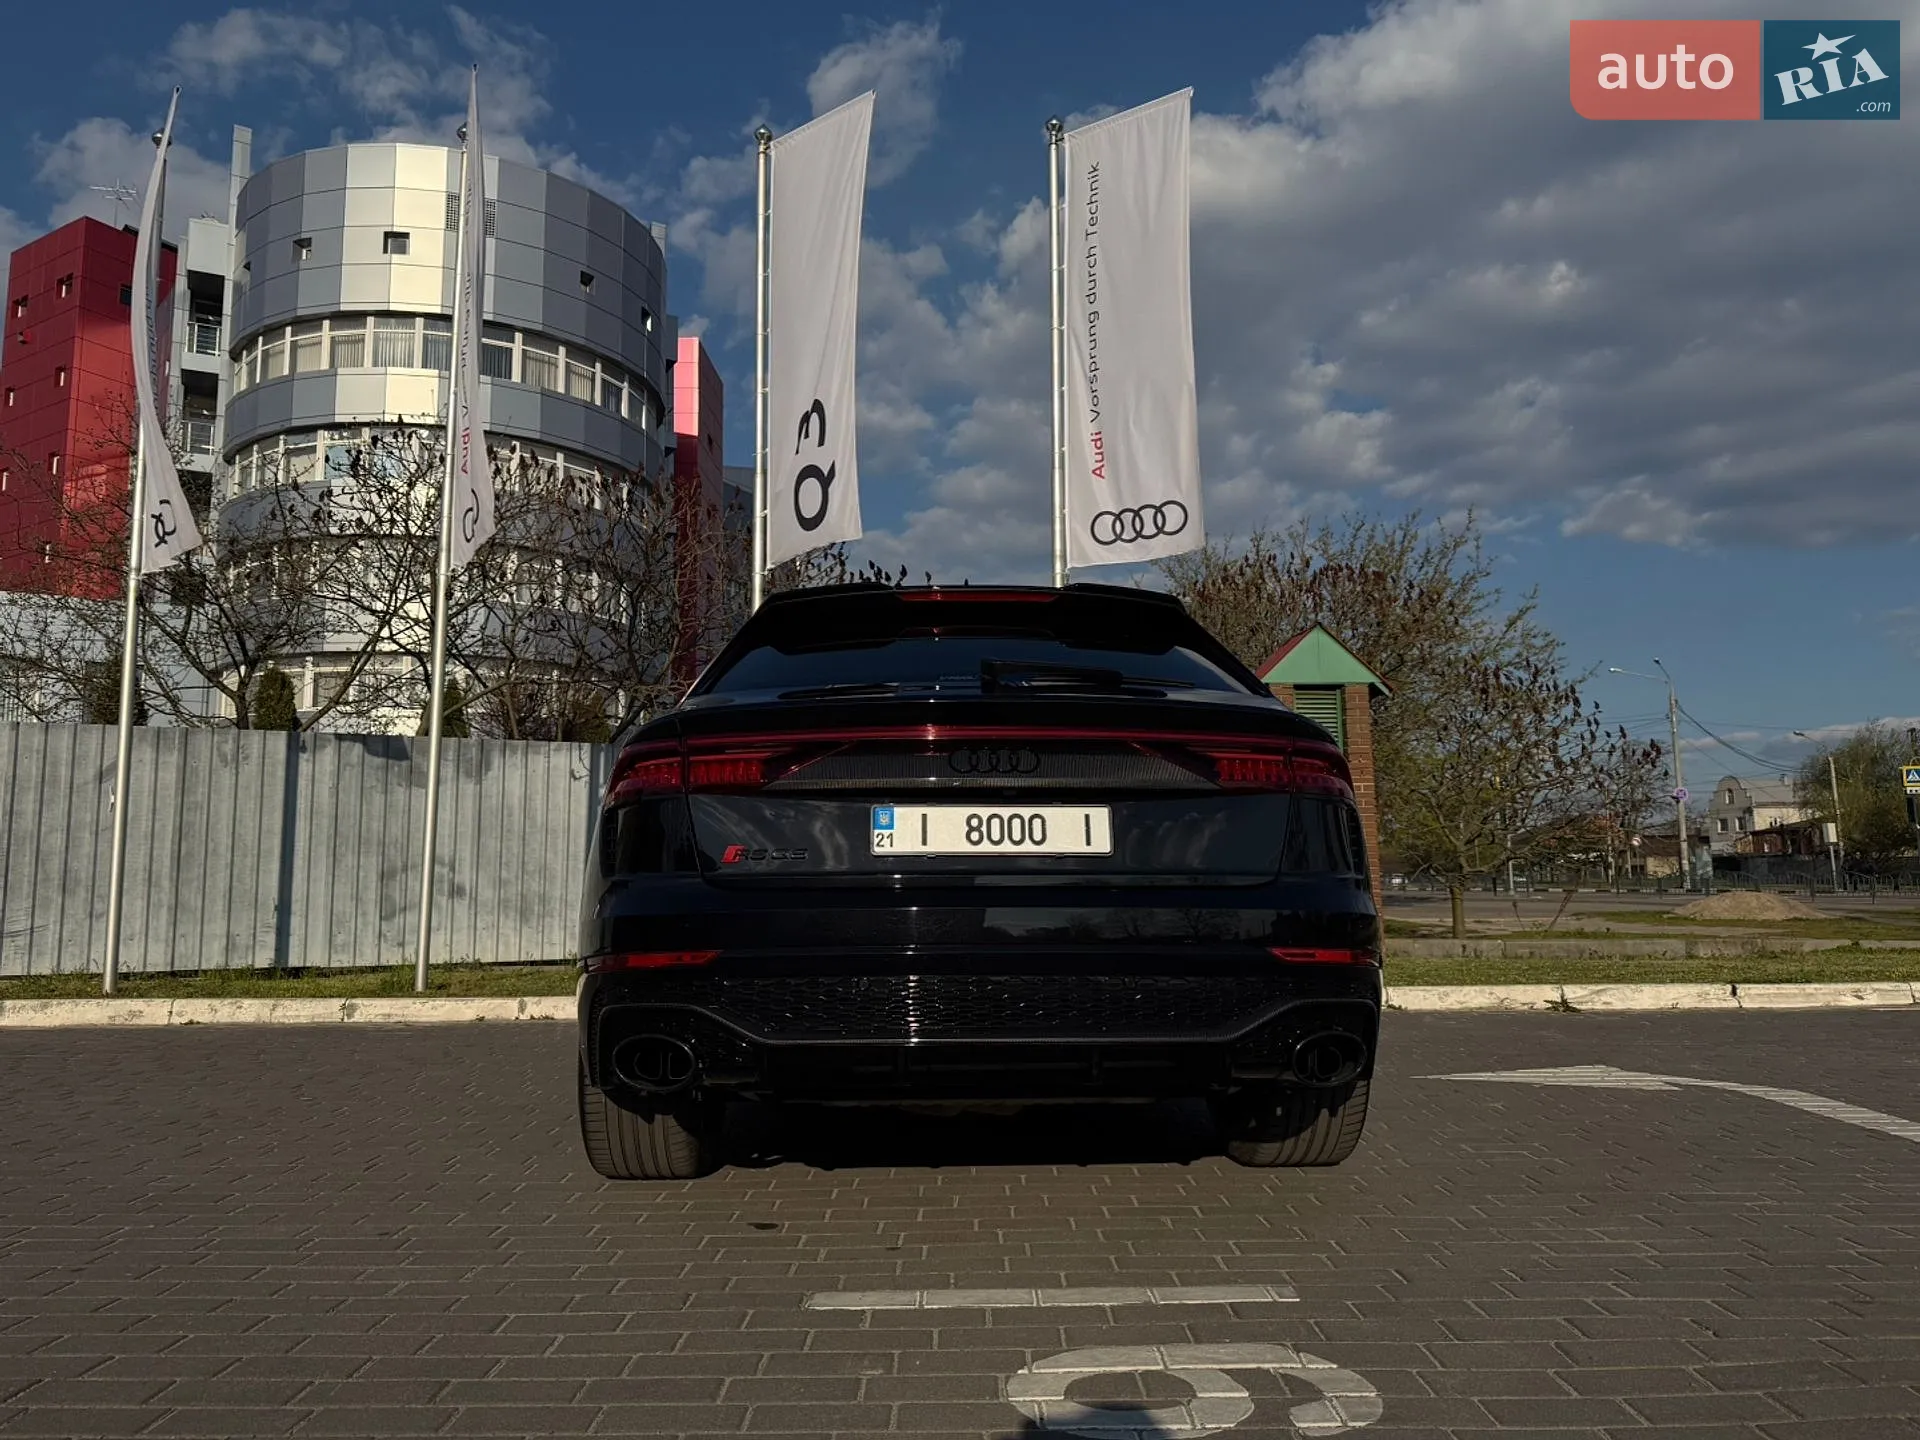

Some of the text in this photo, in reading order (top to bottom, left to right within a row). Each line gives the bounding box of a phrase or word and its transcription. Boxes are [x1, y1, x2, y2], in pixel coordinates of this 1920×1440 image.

[1084, 161, 1105, 479] Audi Vorsprung durch Technik
[461, 427, 471, 475] Audi
[794, 398, 836, 532] Q3
[875, 832, 894, 848] 21
[965, 813, 1047, 846] 8000
